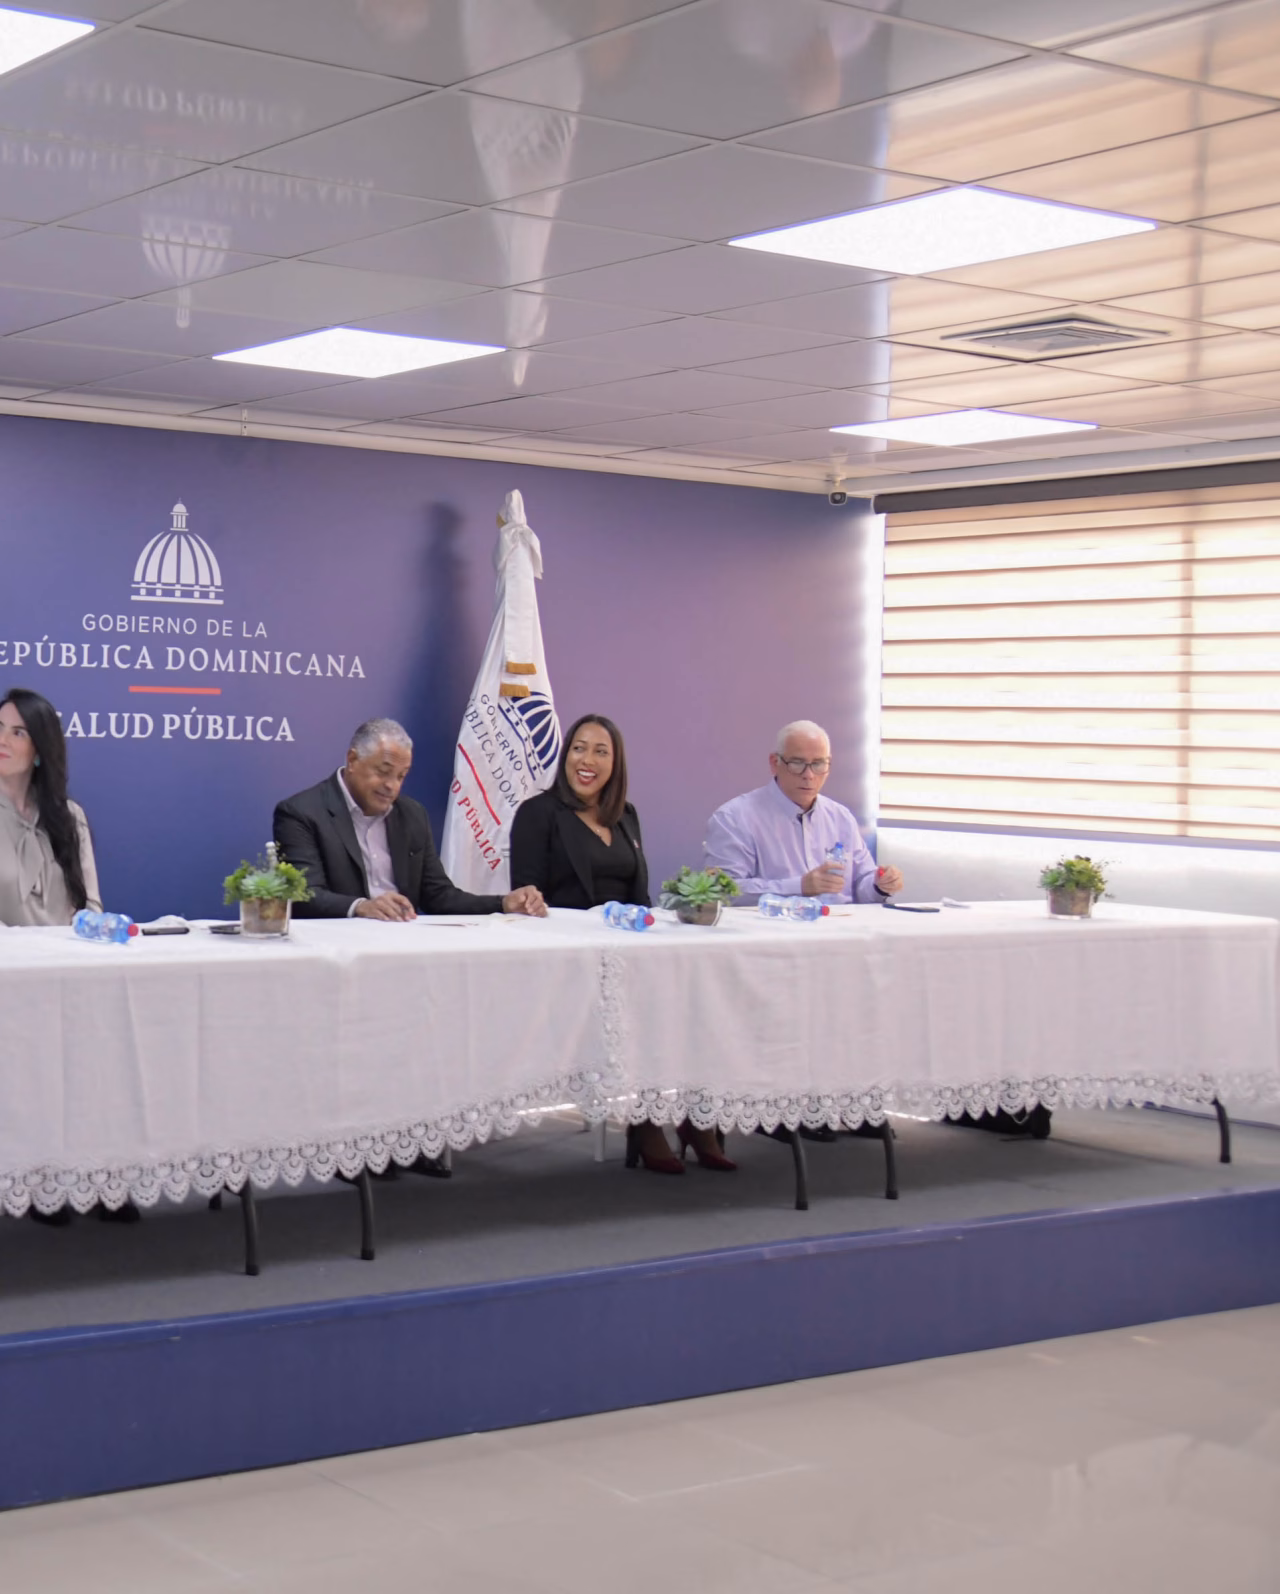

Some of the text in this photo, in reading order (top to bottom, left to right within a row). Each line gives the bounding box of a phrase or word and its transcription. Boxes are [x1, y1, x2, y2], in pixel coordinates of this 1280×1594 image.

[82, 613, 267, 638] GOBIERNO DE LA
[165, 646, 366, 678] DOMINICANA
[56, 706, 295, 741] ALUD PÚBLICA
[465, 703, 495, 763] BLICA
[457, 796, 501, 871] PÚBLICA
